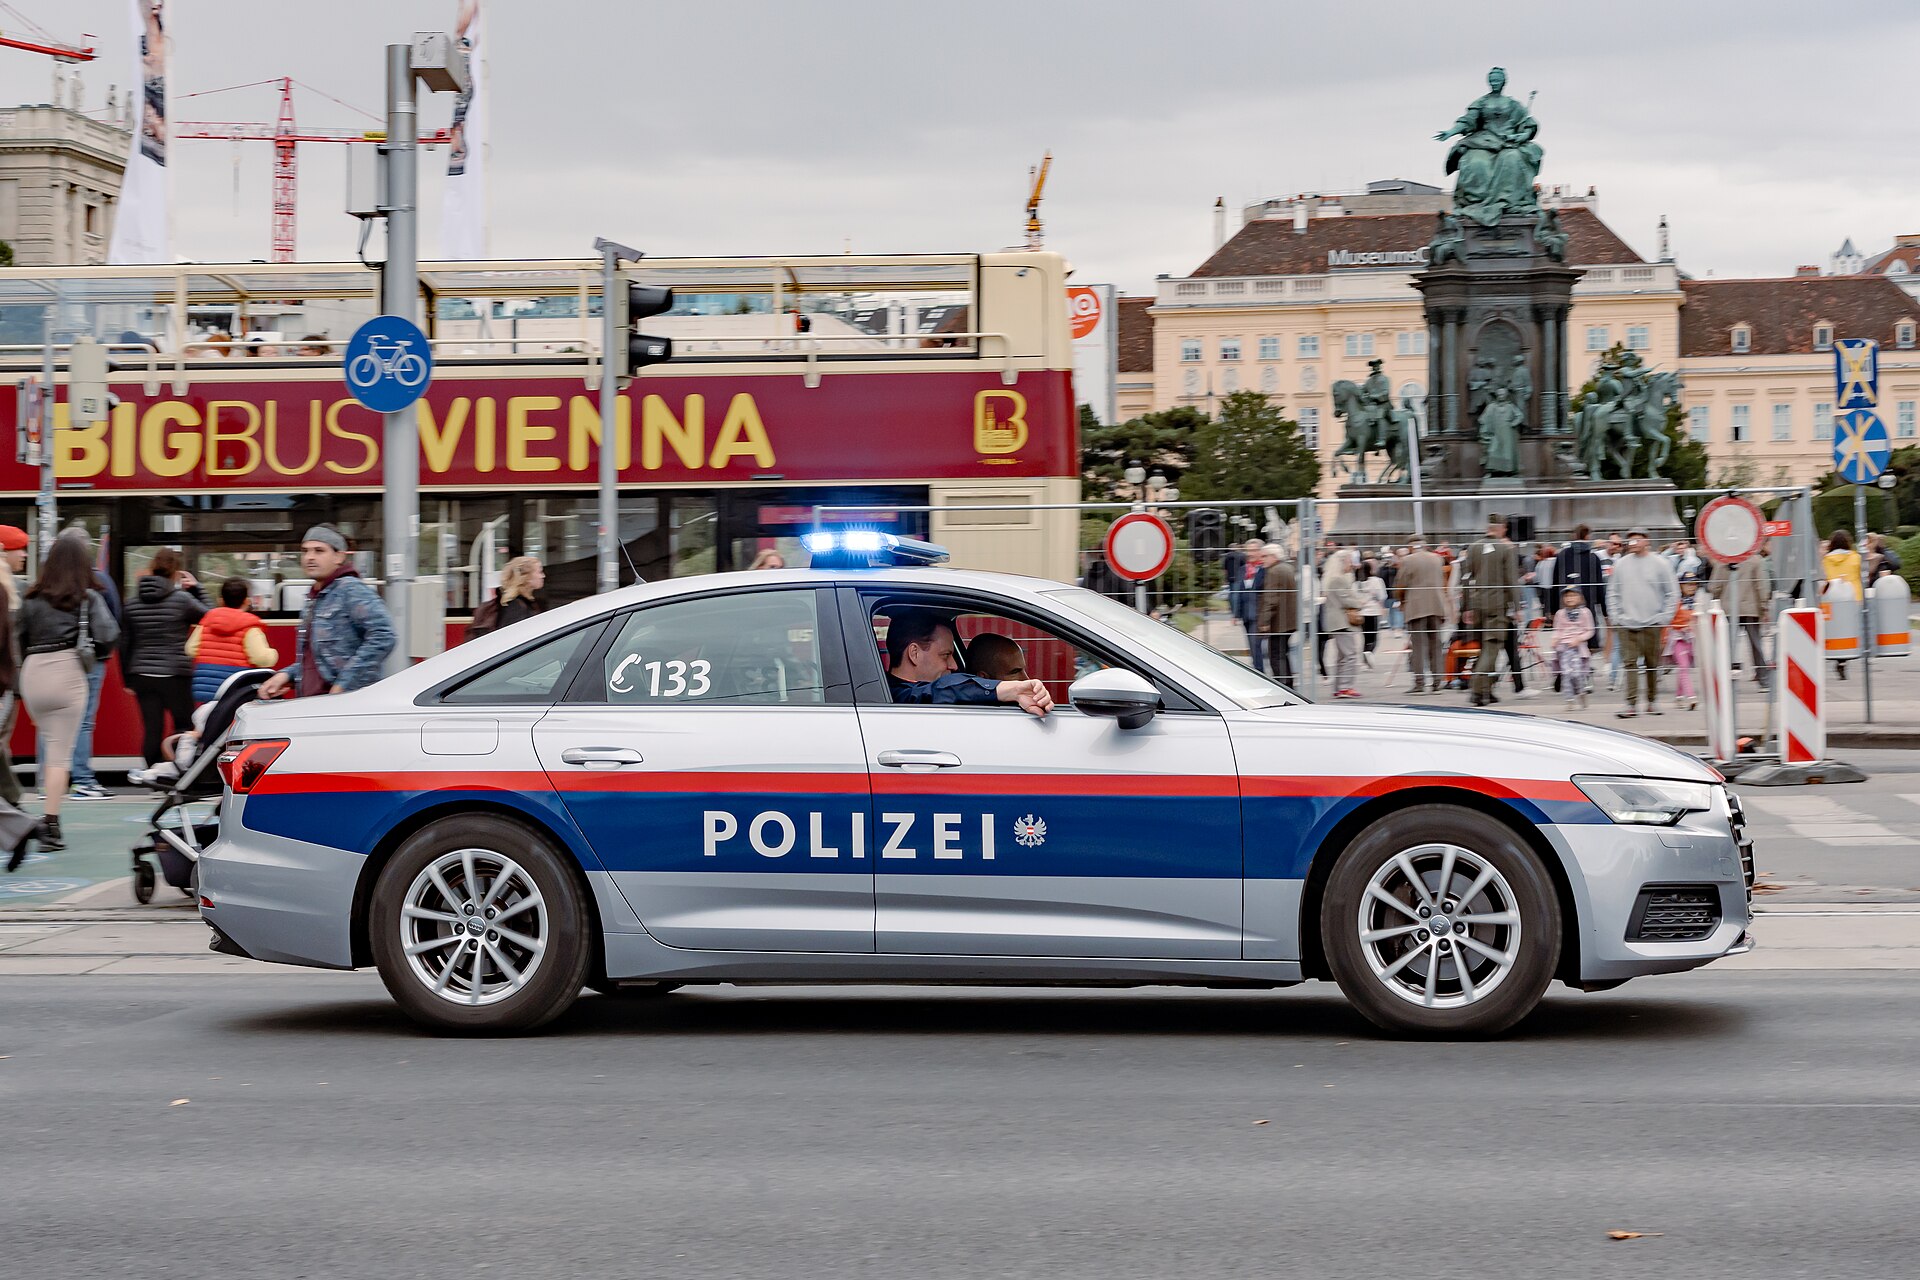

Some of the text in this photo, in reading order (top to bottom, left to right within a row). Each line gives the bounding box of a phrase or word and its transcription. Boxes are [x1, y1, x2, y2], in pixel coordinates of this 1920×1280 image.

[416, 393, 776, 473] VIENNA
[645, 660, 711, 697] 133
[703, 810, 995, 860] POLIZEI
